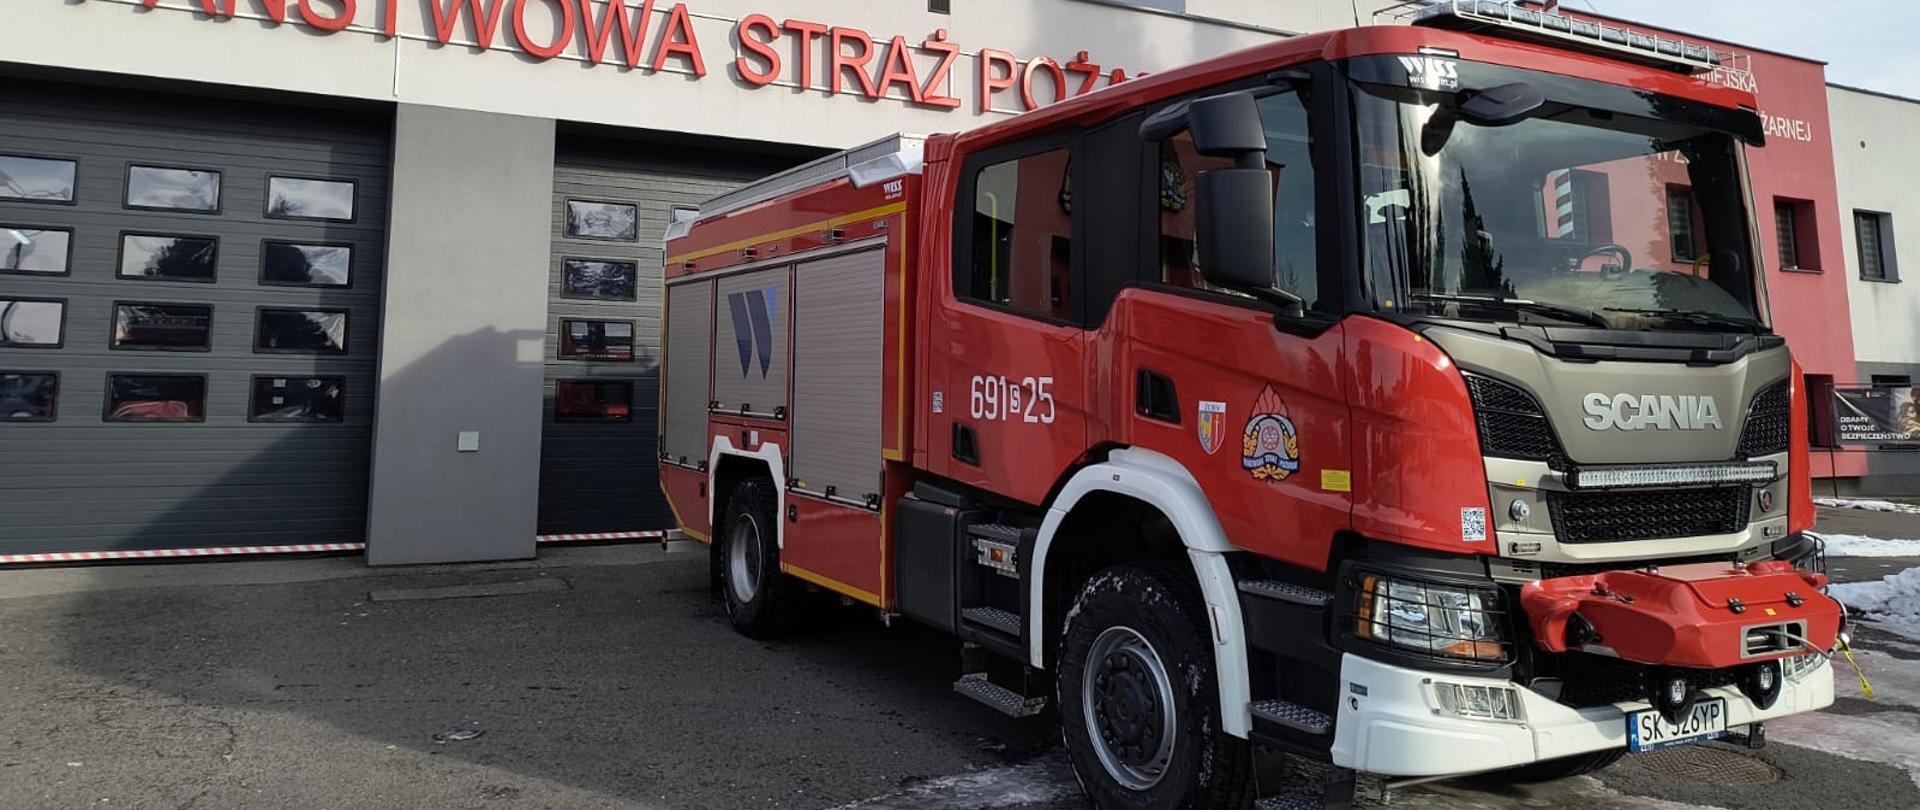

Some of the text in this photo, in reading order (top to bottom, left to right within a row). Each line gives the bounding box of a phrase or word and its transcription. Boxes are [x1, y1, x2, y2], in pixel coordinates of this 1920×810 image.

[76, 0, 706, 77] TWOWA
[737, 13, 961, 108] STRAŻ
[1759, 110, 1812, 142] ŻARNEJ
[1583, 392, 1723, 430] SCANIA
[1642, 713, 1664, 742] SK
